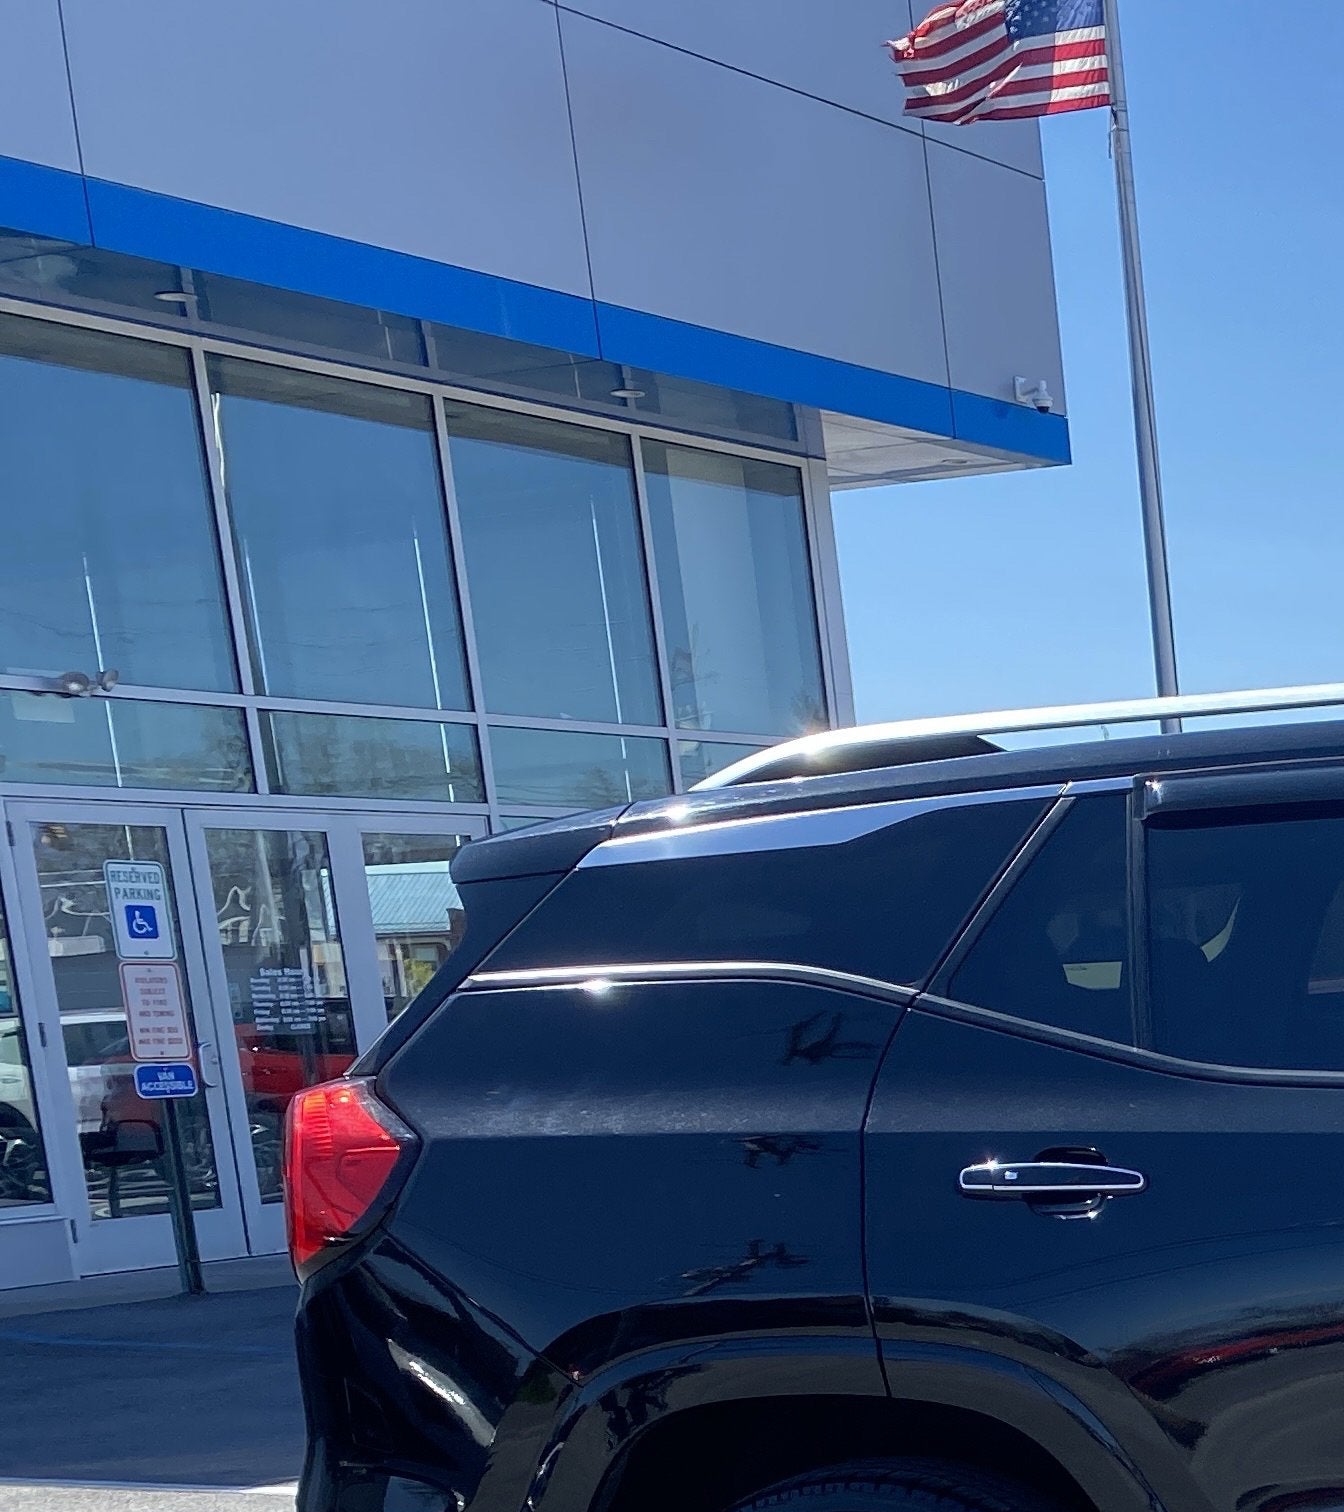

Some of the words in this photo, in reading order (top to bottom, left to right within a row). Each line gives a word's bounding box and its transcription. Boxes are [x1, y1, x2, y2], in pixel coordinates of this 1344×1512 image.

[110, 870, 160, 884] RESERVED
[113, 887, 160, 900] PARKING
[157, 1072, 175, 1081] VAN
[141, 1080, 194, 1091] ACCESSIBLE
